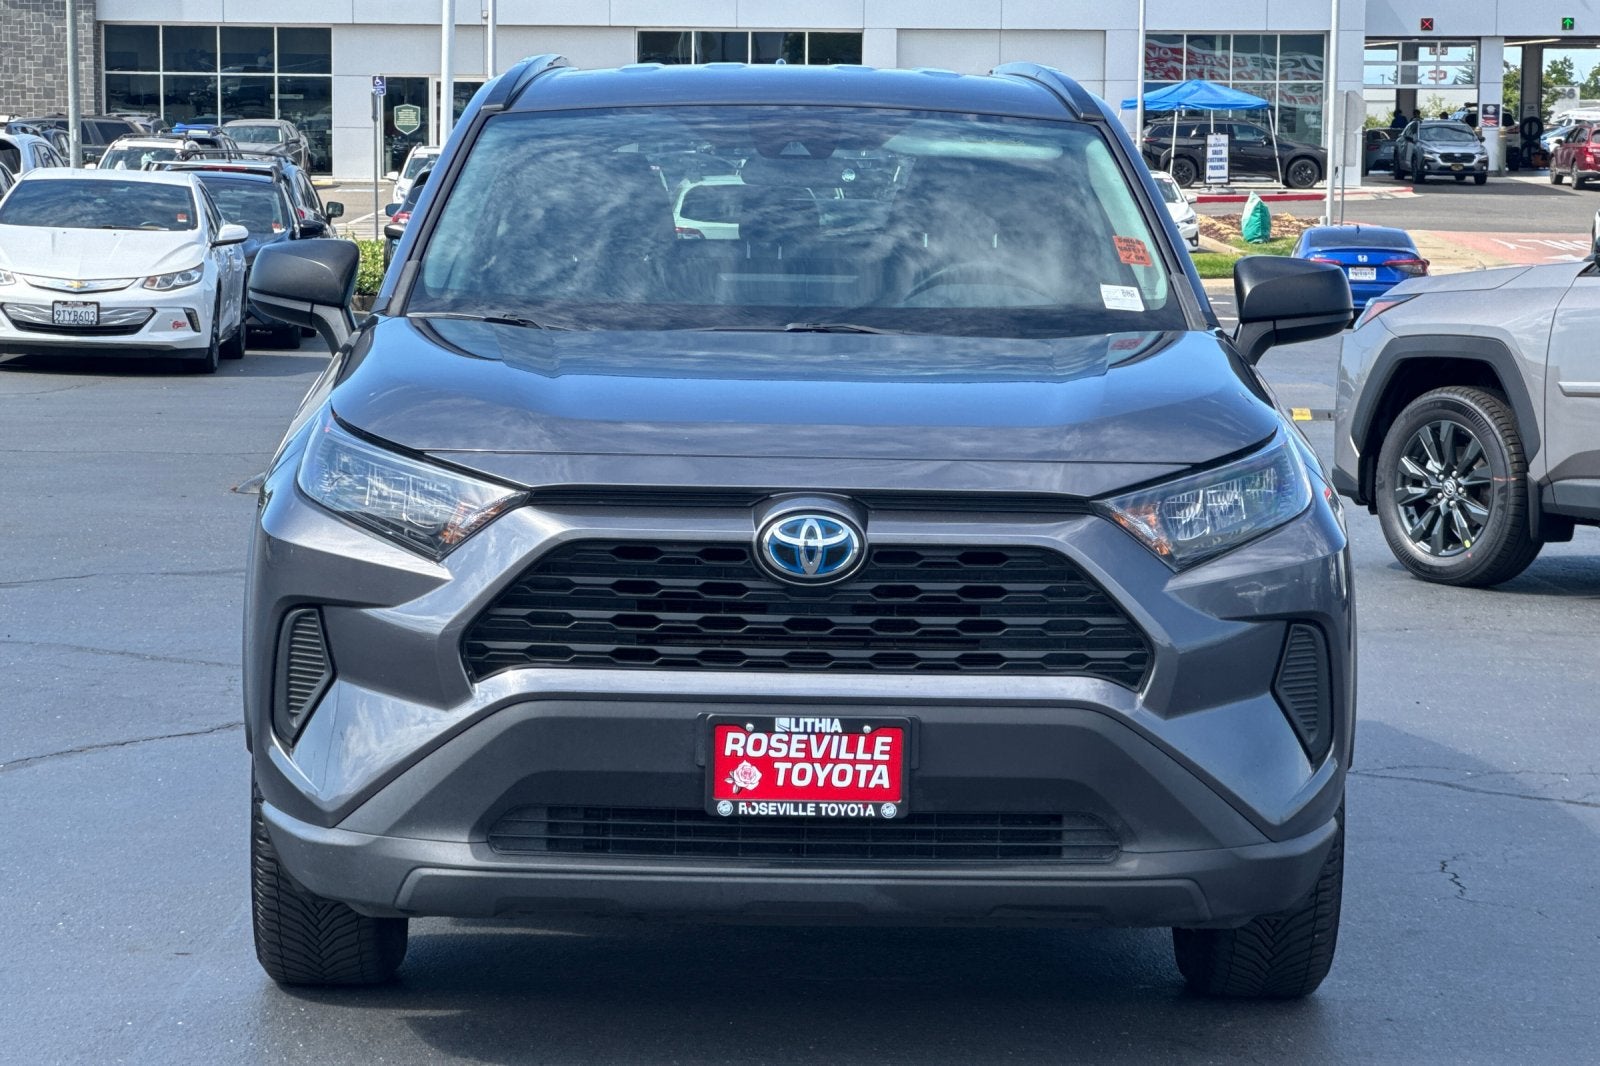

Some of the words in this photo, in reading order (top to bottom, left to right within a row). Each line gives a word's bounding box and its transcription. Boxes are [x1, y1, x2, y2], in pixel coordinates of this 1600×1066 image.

[55, 309, 96, 321] 9TYB603
[791, 717, 843, 733] LITHIA
[724, 732, 893, 761] ROSEVILLE
[773, 761, 890, 788] TOYOTA
[738, 802, 816, 816] ROSEVILLE
[820, 803, 875, 817] TOYOTA
